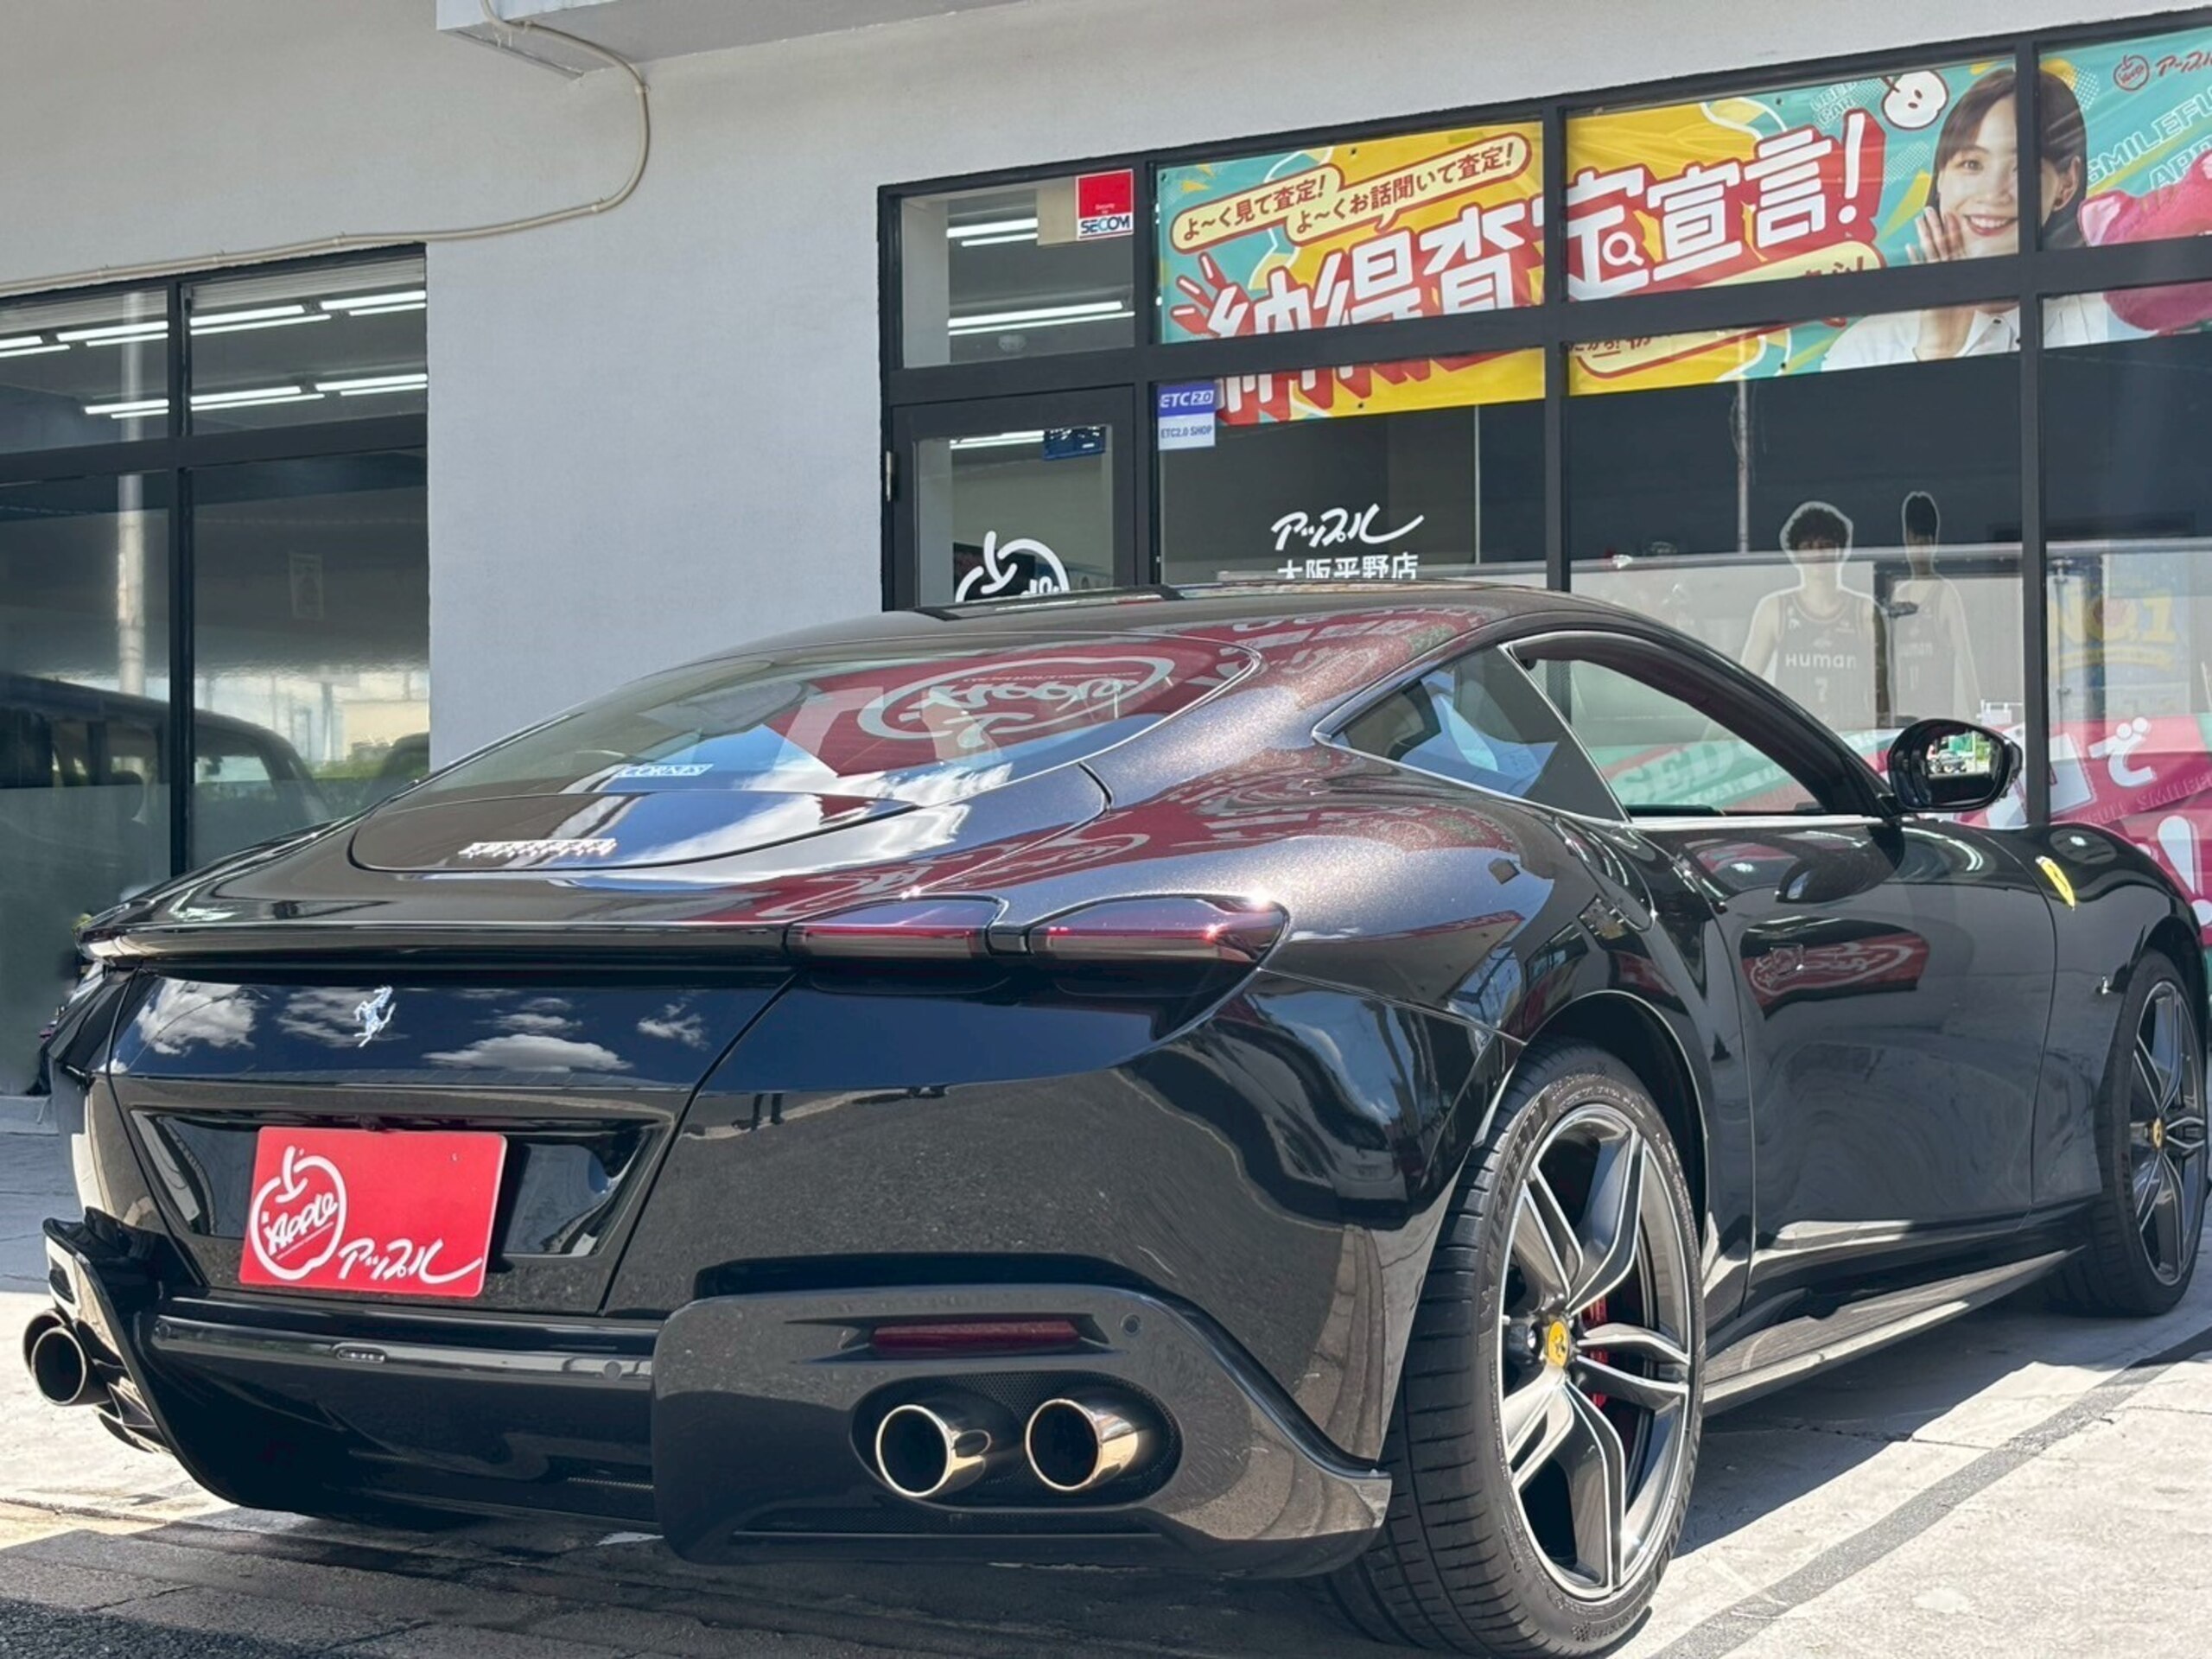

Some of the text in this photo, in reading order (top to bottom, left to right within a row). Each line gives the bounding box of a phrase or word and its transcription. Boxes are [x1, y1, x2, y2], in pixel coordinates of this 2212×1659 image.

[1081, 215, 1130, 234] SECOM
[1270, 503, 1425, 551] アップル
[338, 1238, 483, 1284] アップル
